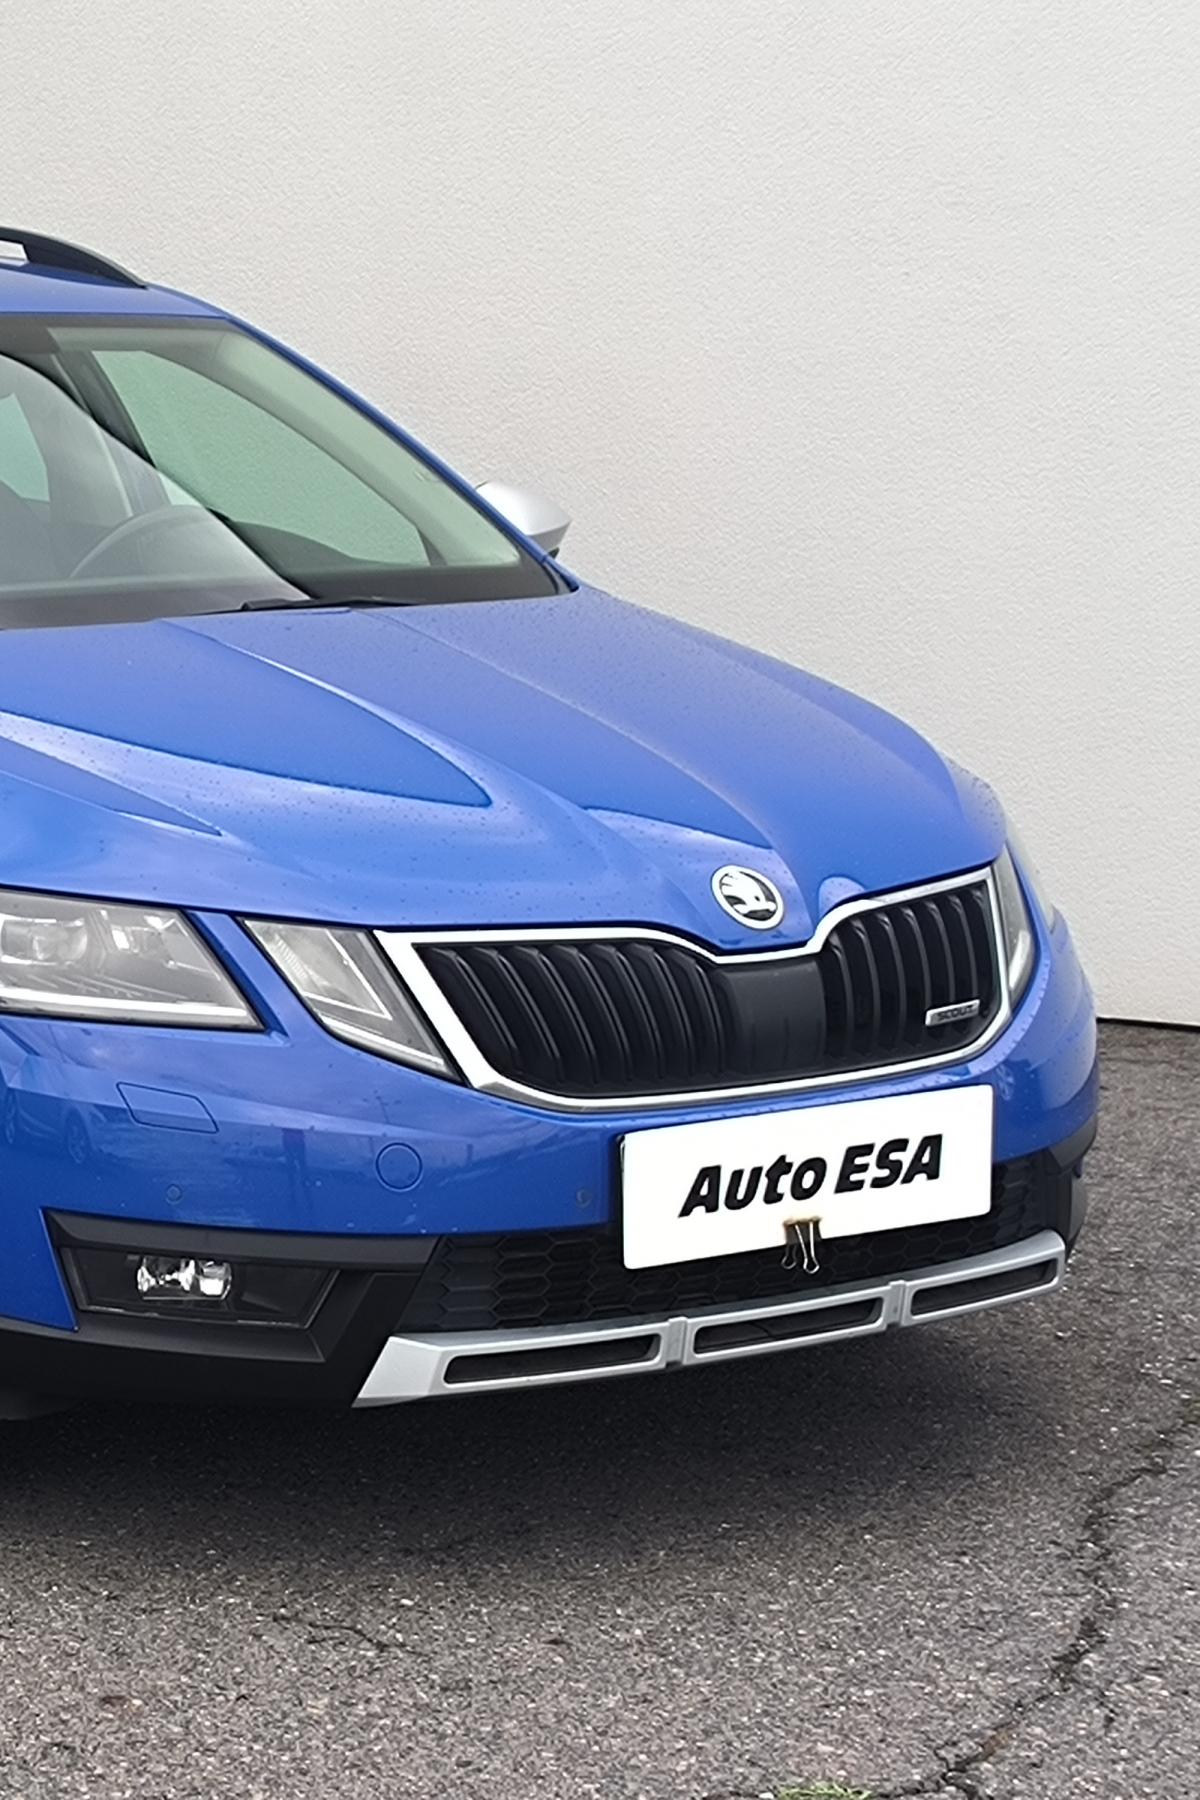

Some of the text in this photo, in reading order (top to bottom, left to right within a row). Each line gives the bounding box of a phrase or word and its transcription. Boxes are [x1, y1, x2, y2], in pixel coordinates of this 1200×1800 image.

[936, 1004, 974, 1021] SCOUT
[678, 1134, 944, 1218] Auto ESA
